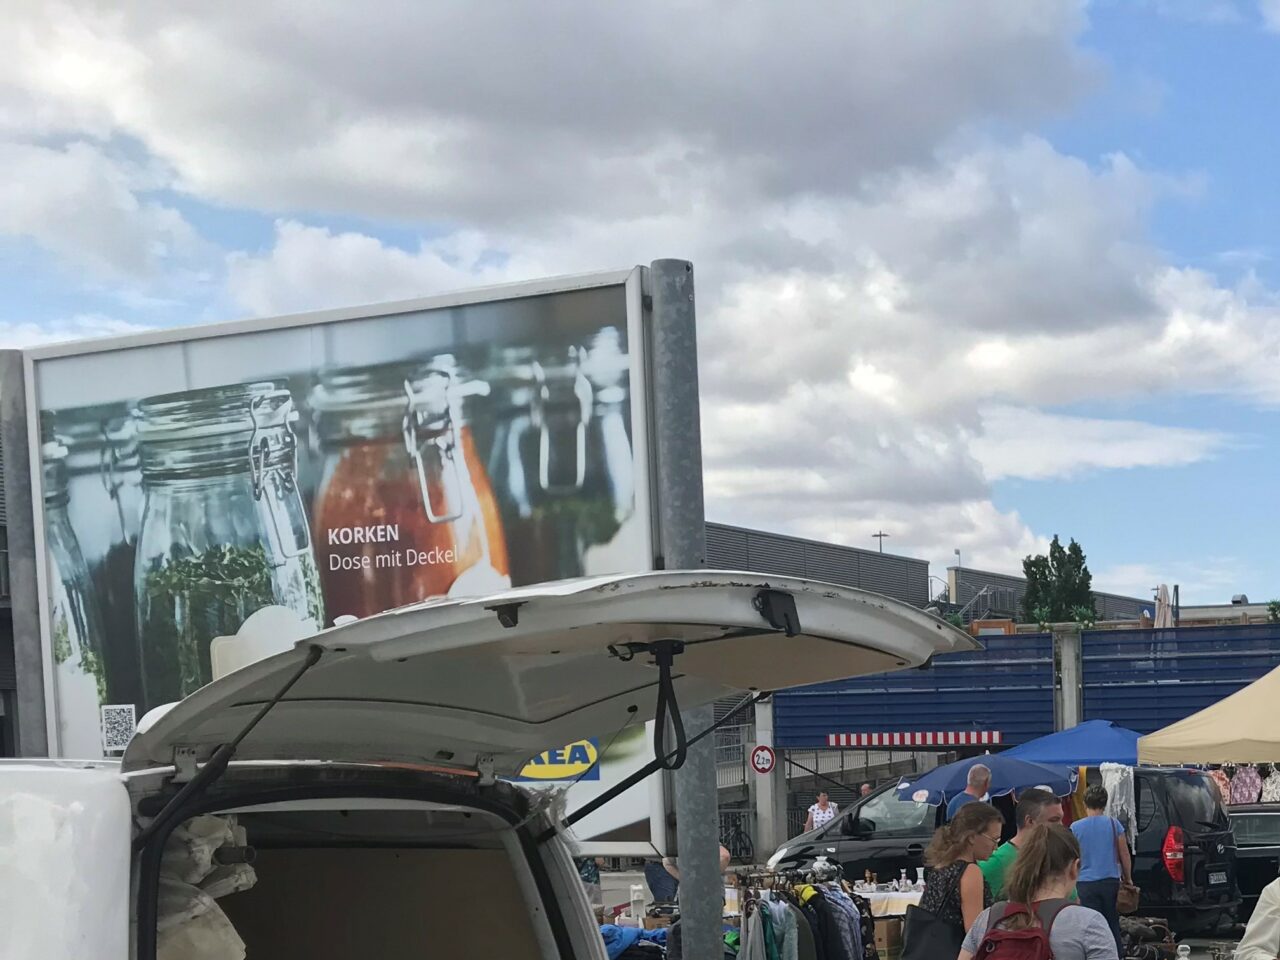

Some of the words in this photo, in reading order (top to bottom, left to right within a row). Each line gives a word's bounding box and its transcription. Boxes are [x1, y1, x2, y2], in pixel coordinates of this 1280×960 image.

[327, 524, 400, 546] KORKEN
[329, 553, 370, 571] Dose
[375, 550, 402, 568] mit
[406, 545, 459, 566] Deckel
